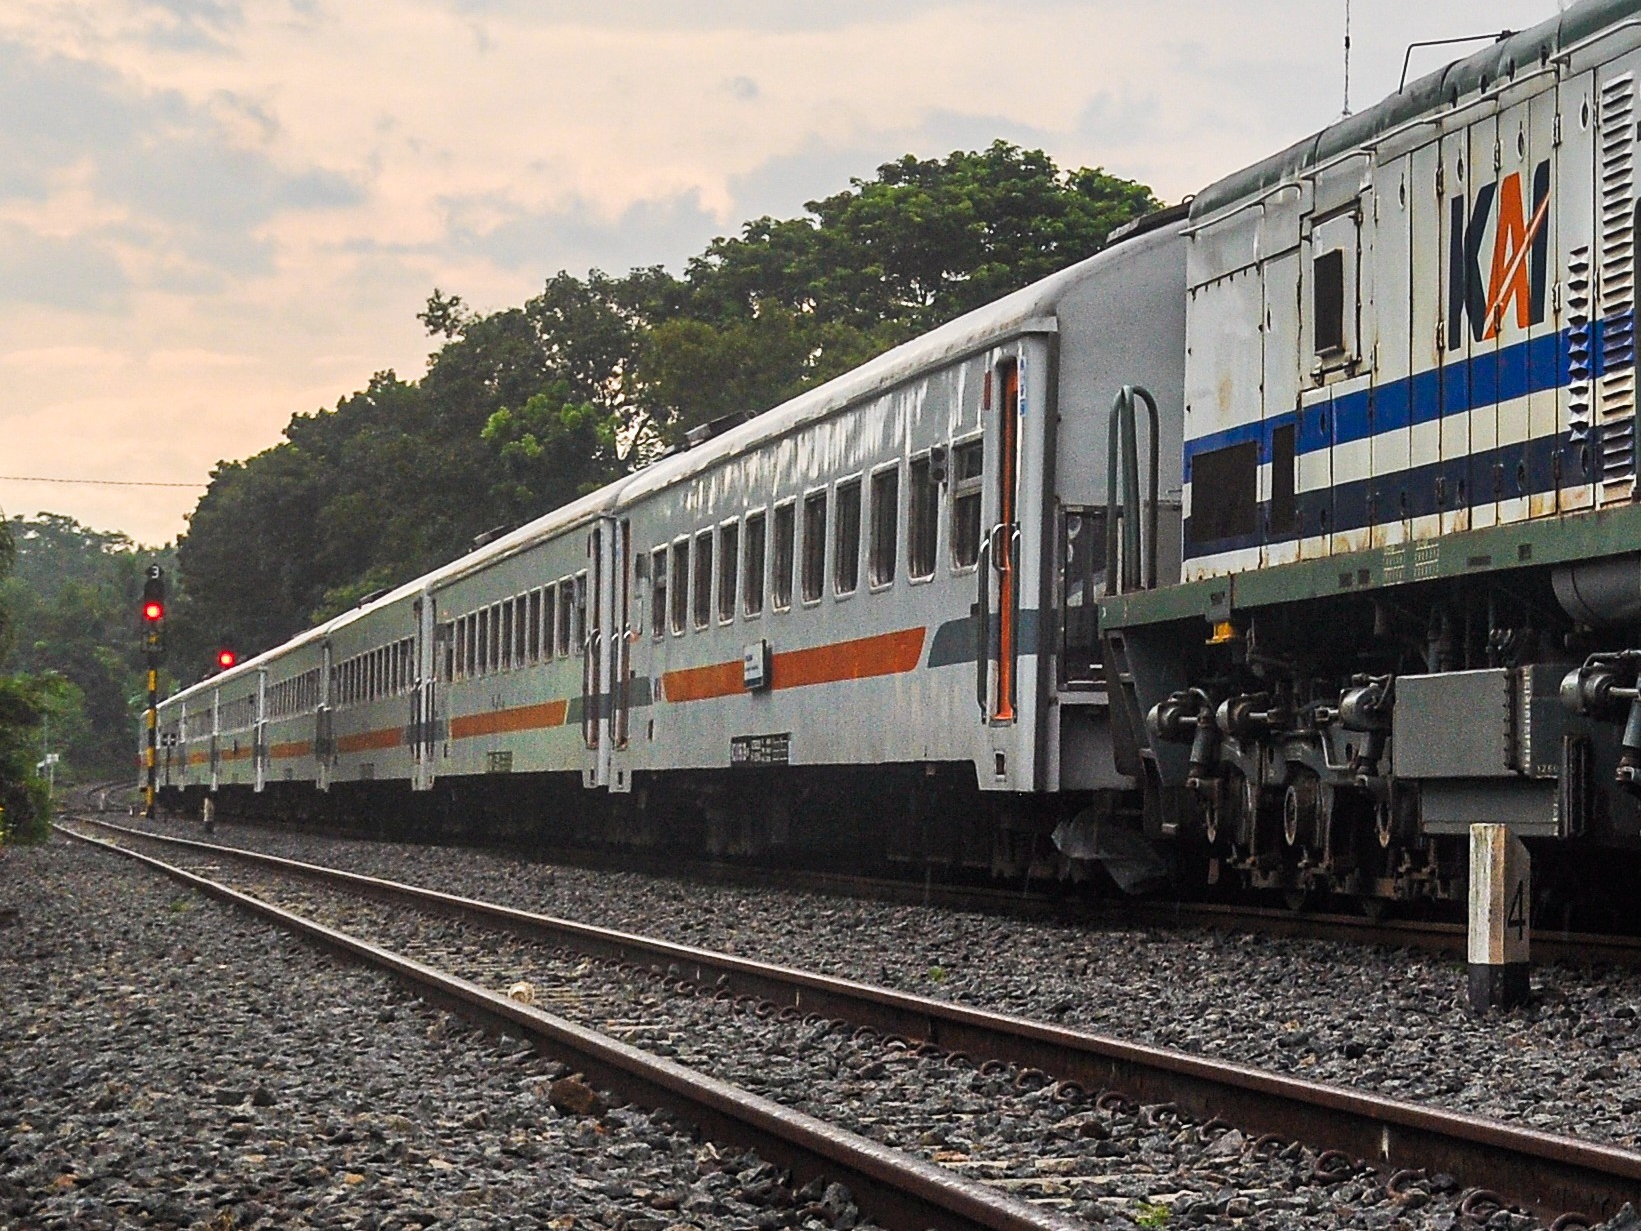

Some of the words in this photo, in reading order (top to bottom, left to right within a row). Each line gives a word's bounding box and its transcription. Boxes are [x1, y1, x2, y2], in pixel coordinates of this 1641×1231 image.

[1448, 158, 1550, 351] KAI
[151, 565, 160, 579] 3
[1507, 880, 1526, 941] 4
